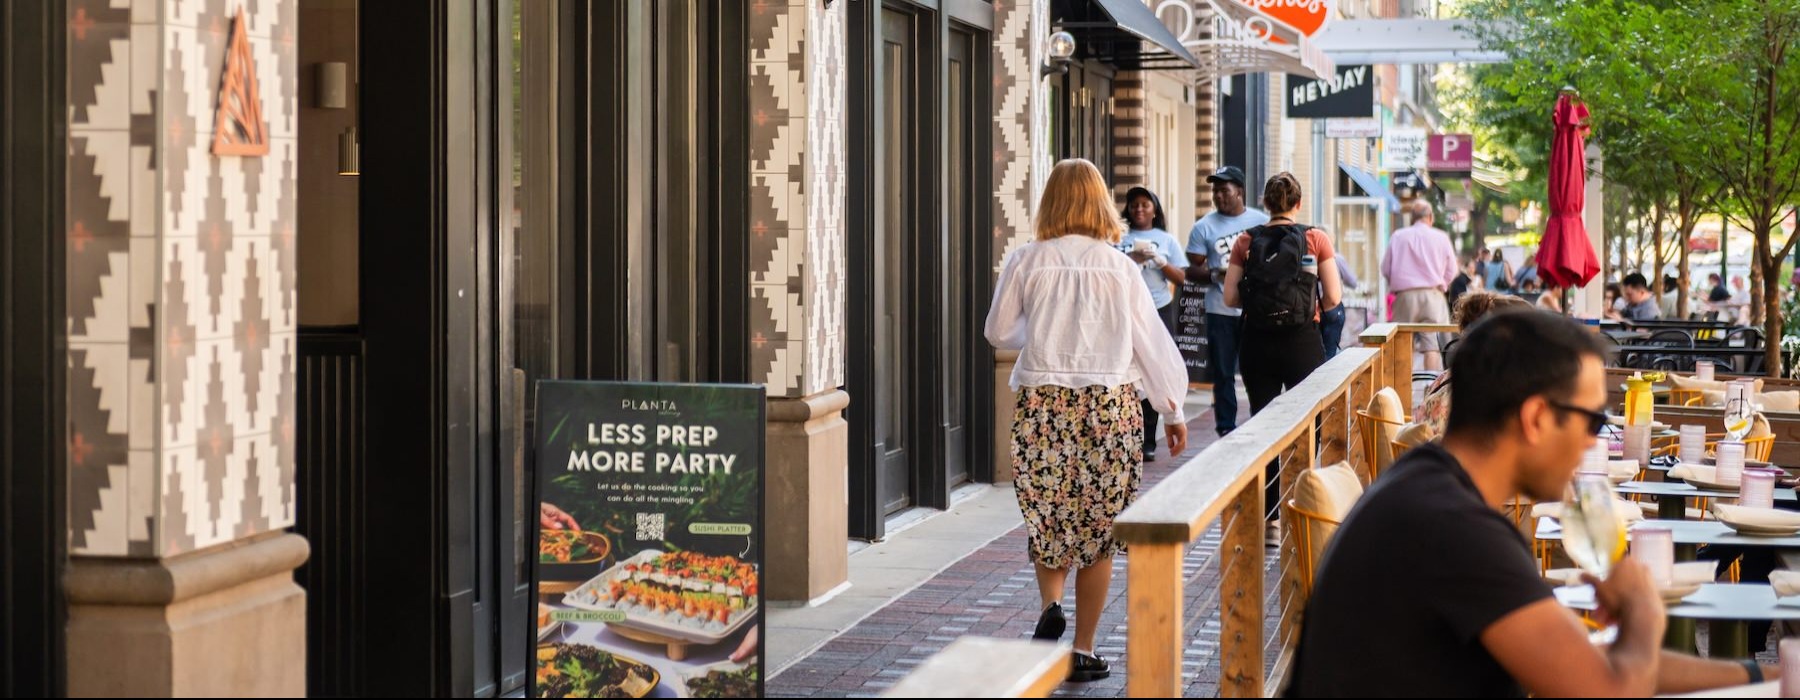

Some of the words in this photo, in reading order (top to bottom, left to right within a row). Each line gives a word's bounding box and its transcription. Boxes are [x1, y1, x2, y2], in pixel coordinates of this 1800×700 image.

[1292, 65, 1367, 107] HEYDAY
[1442, 136, 1459, 161] P
[621, 399, 677, 411] PLANTA
[587, 422, 647, 445] LESS
[656, 425, 719, 447] PREP
[567, 450, 645, 473] MORE
[655, 453, 737, 475] PARTY
[597, 482, 609, 490] Let
[621, 482, 631, 490] do
[633, 483, 646, 491] the
[647, 483, 677, 493] cooking
[679, 484, 688, 492] so
[690, 485, 704, 493] you
[623, 494, 633, 502] do
[661, 495, 694, 505] mingling
[582, 612, 621, 620] BROCCOLI
